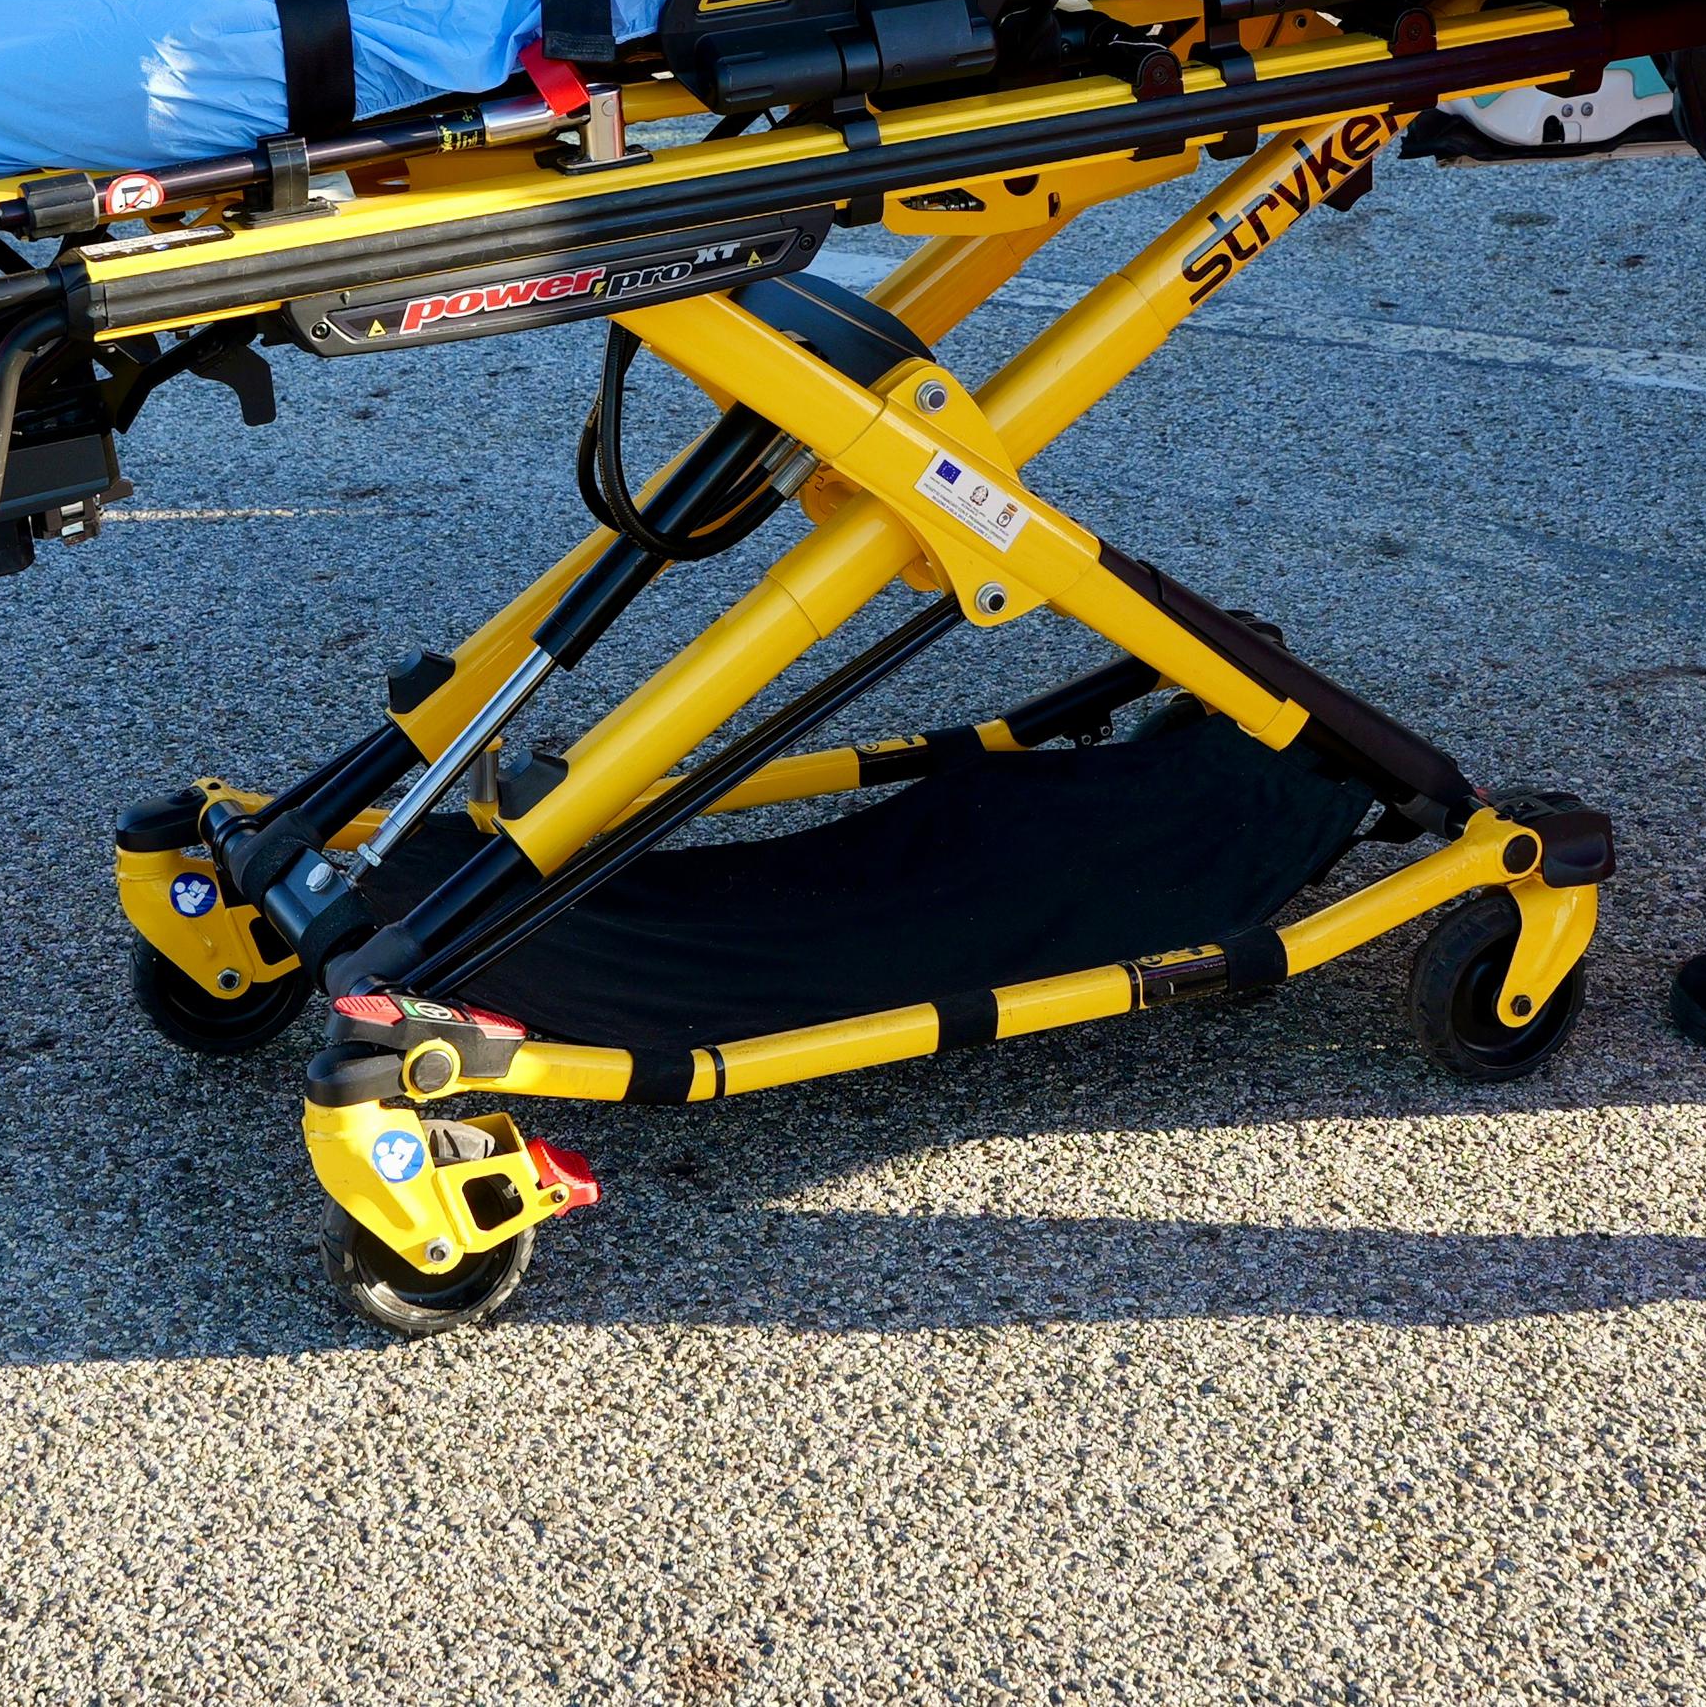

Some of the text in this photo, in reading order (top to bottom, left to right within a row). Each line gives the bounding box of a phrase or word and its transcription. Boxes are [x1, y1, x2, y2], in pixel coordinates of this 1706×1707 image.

[399, 243, 741, 334] power pro XT
